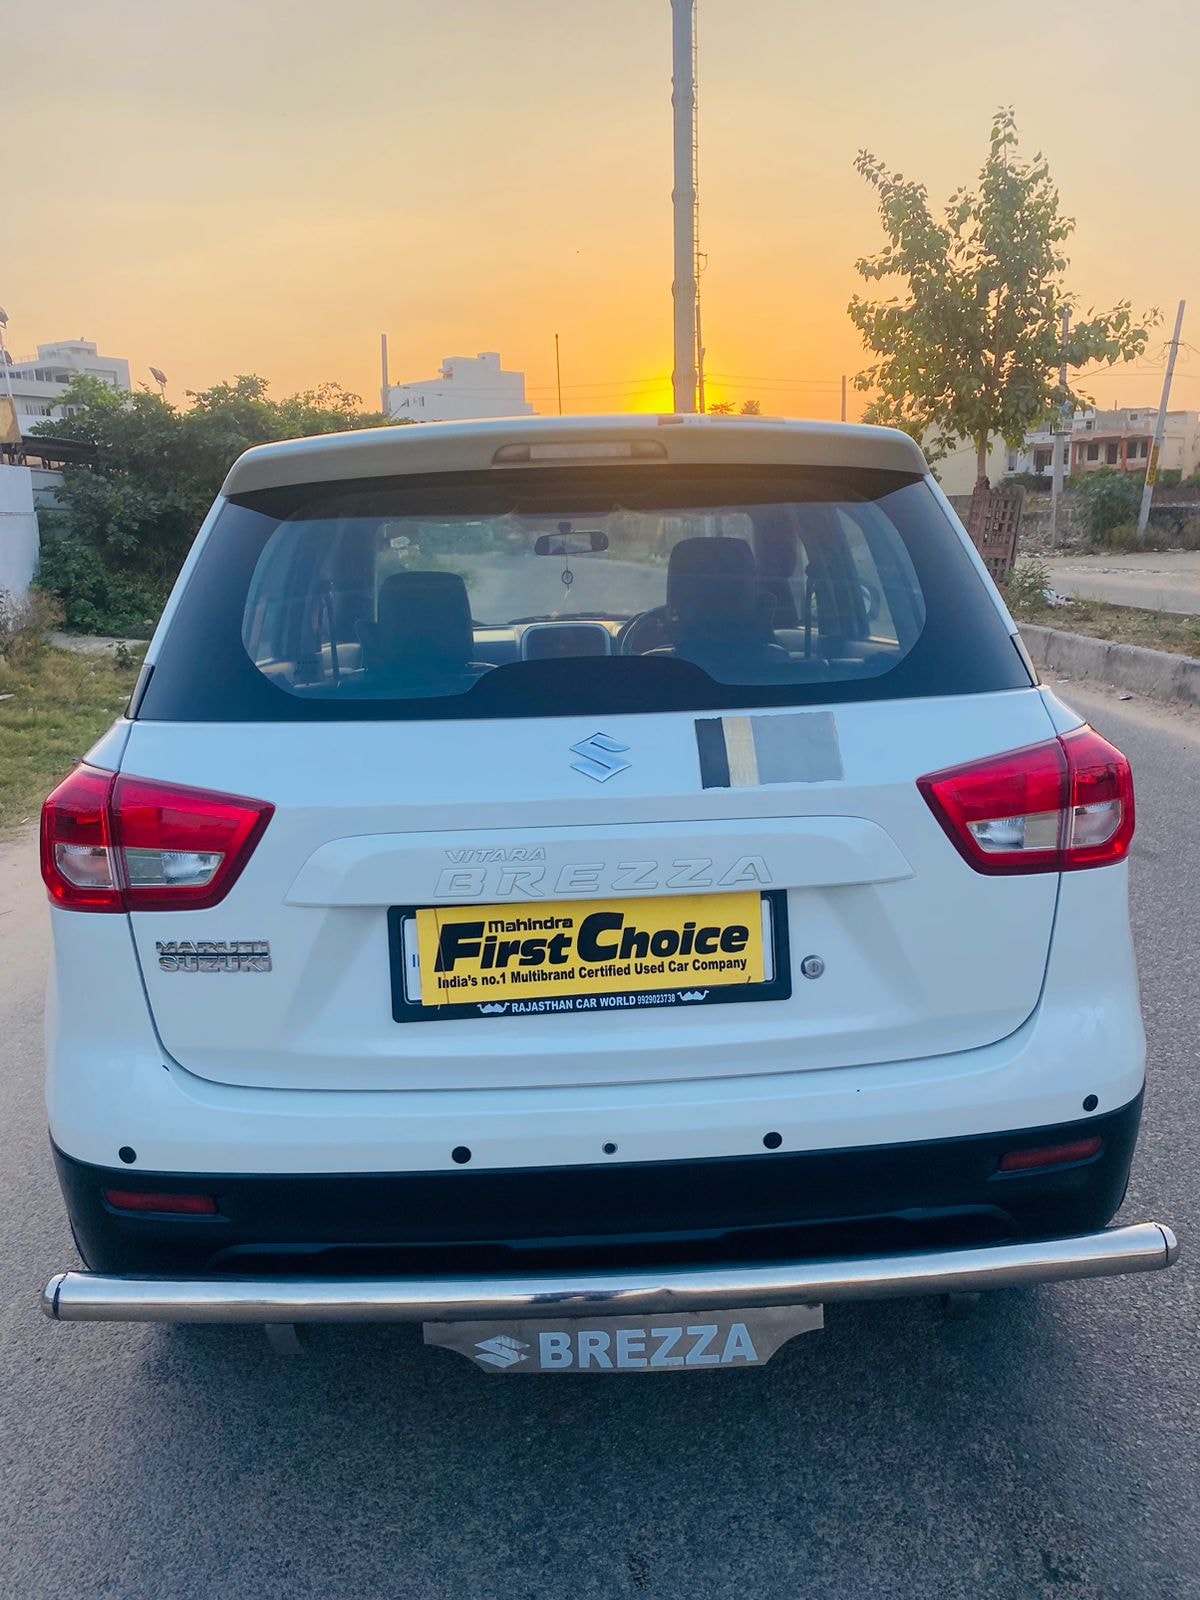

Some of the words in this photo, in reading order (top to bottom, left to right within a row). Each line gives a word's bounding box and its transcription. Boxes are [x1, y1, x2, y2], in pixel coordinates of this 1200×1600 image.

[445, 847, 546, 864] VITARA
[433, 855, 774, 898] BREZZA
[488, 916, 573, 933] Mahindra
[155, 940, 271, 953] MARUTI
[434, 921, 573, 973] First
[577, 911, 750, 963] Choice
[158, 955, 273, 972] SUZUKI
[438, 974, 478, 989] India's
[481, 972, 507, 986] no.1
[511, 967, 575, 984] Multibrand
[578, 962, 631, 979] Certified
[634, 961, 665, 975] Used
[668, 959, 689, 972] Car
[692, 958, 748, 971] Company
[511, 999, 573, 1013] RAJASTHAN
[576, 998, 597, 1009] CAR
[600, 995, 636, 1007] WORLD
[637, 993, 676, 1005] 9929023738
[538, 1322, 758, 1369] BREZZA
